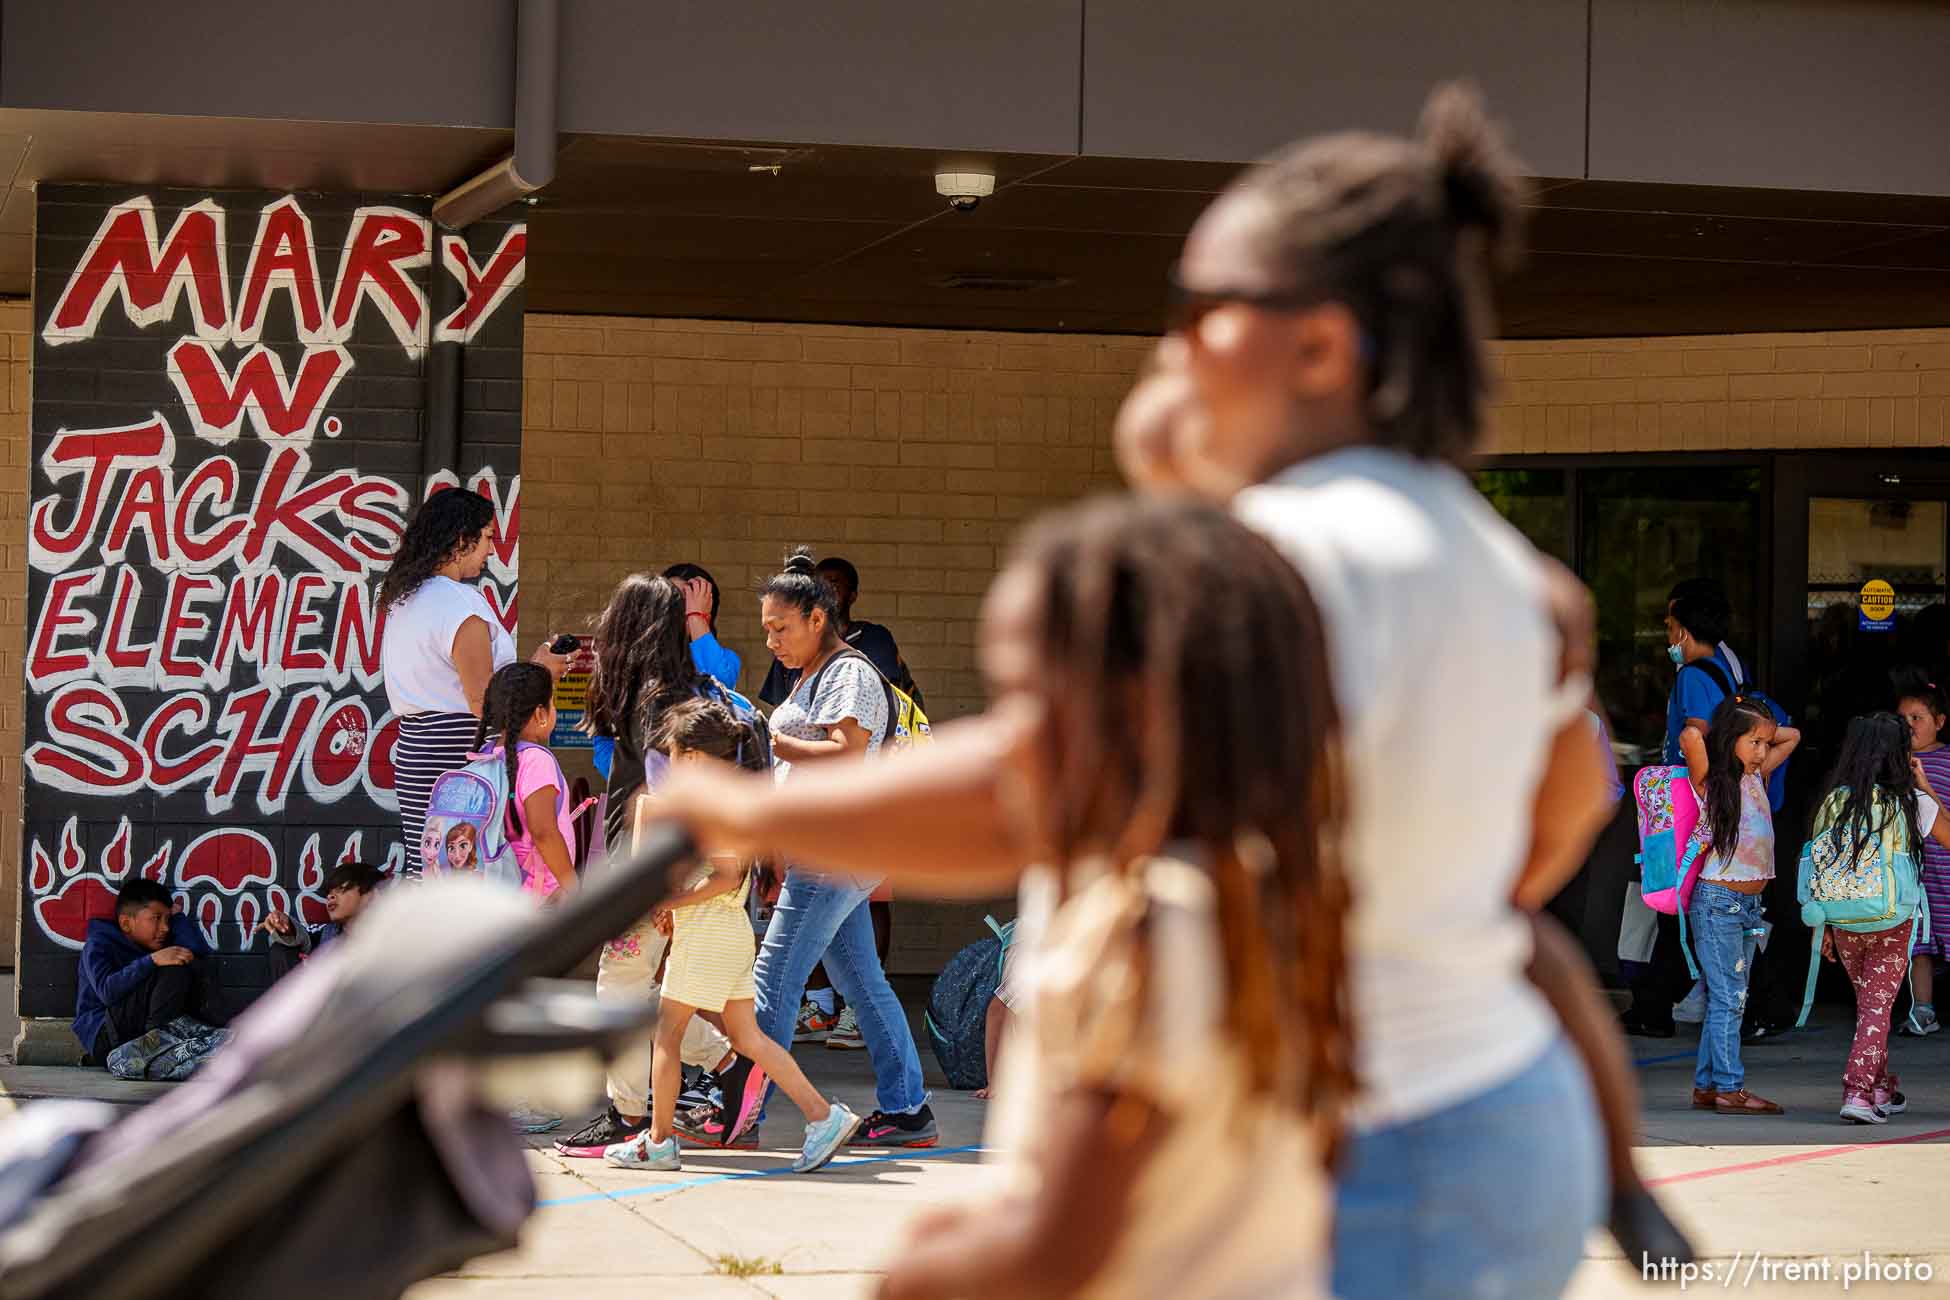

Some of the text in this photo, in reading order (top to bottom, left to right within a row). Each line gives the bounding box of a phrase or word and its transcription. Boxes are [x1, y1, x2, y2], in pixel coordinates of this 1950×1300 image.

[41, 194, 526, 361] MARY
[167, 334, 355, 448] W.
[28, 410, 520, 586] JACKSN
[1862, 595, 1894, 604] CAUTION
[24, 680, 403, 815] SCHOO
